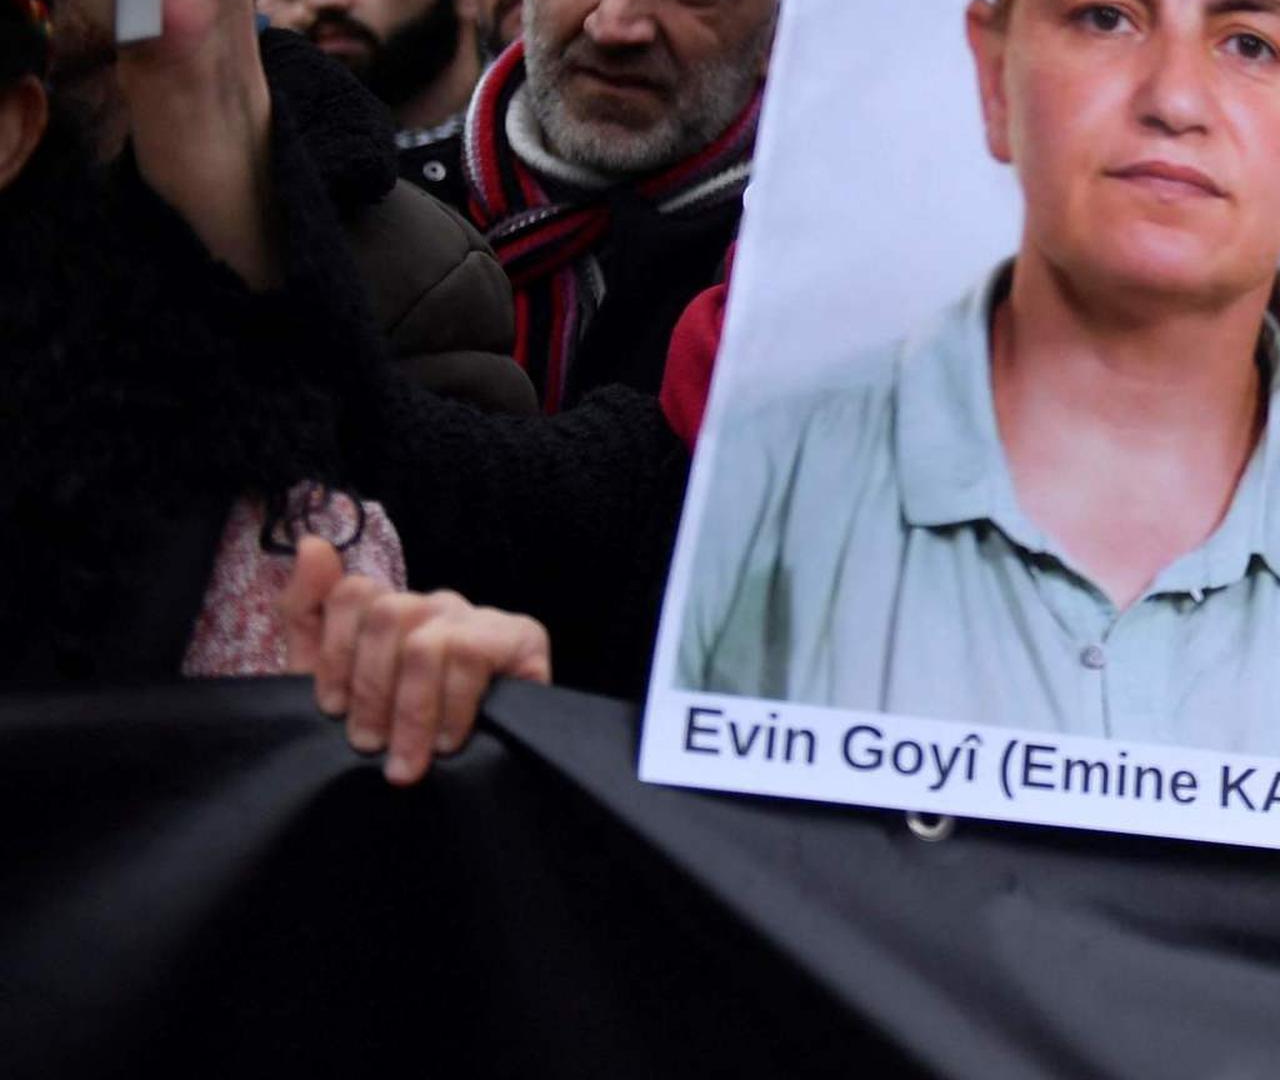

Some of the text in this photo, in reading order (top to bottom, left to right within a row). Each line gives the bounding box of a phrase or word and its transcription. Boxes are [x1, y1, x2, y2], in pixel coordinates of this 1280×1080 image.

[684, 705, 817, 765] Evin
[841, 724, 981, 792] Goyî
[1000, 738, 1199, 805] (Emine
